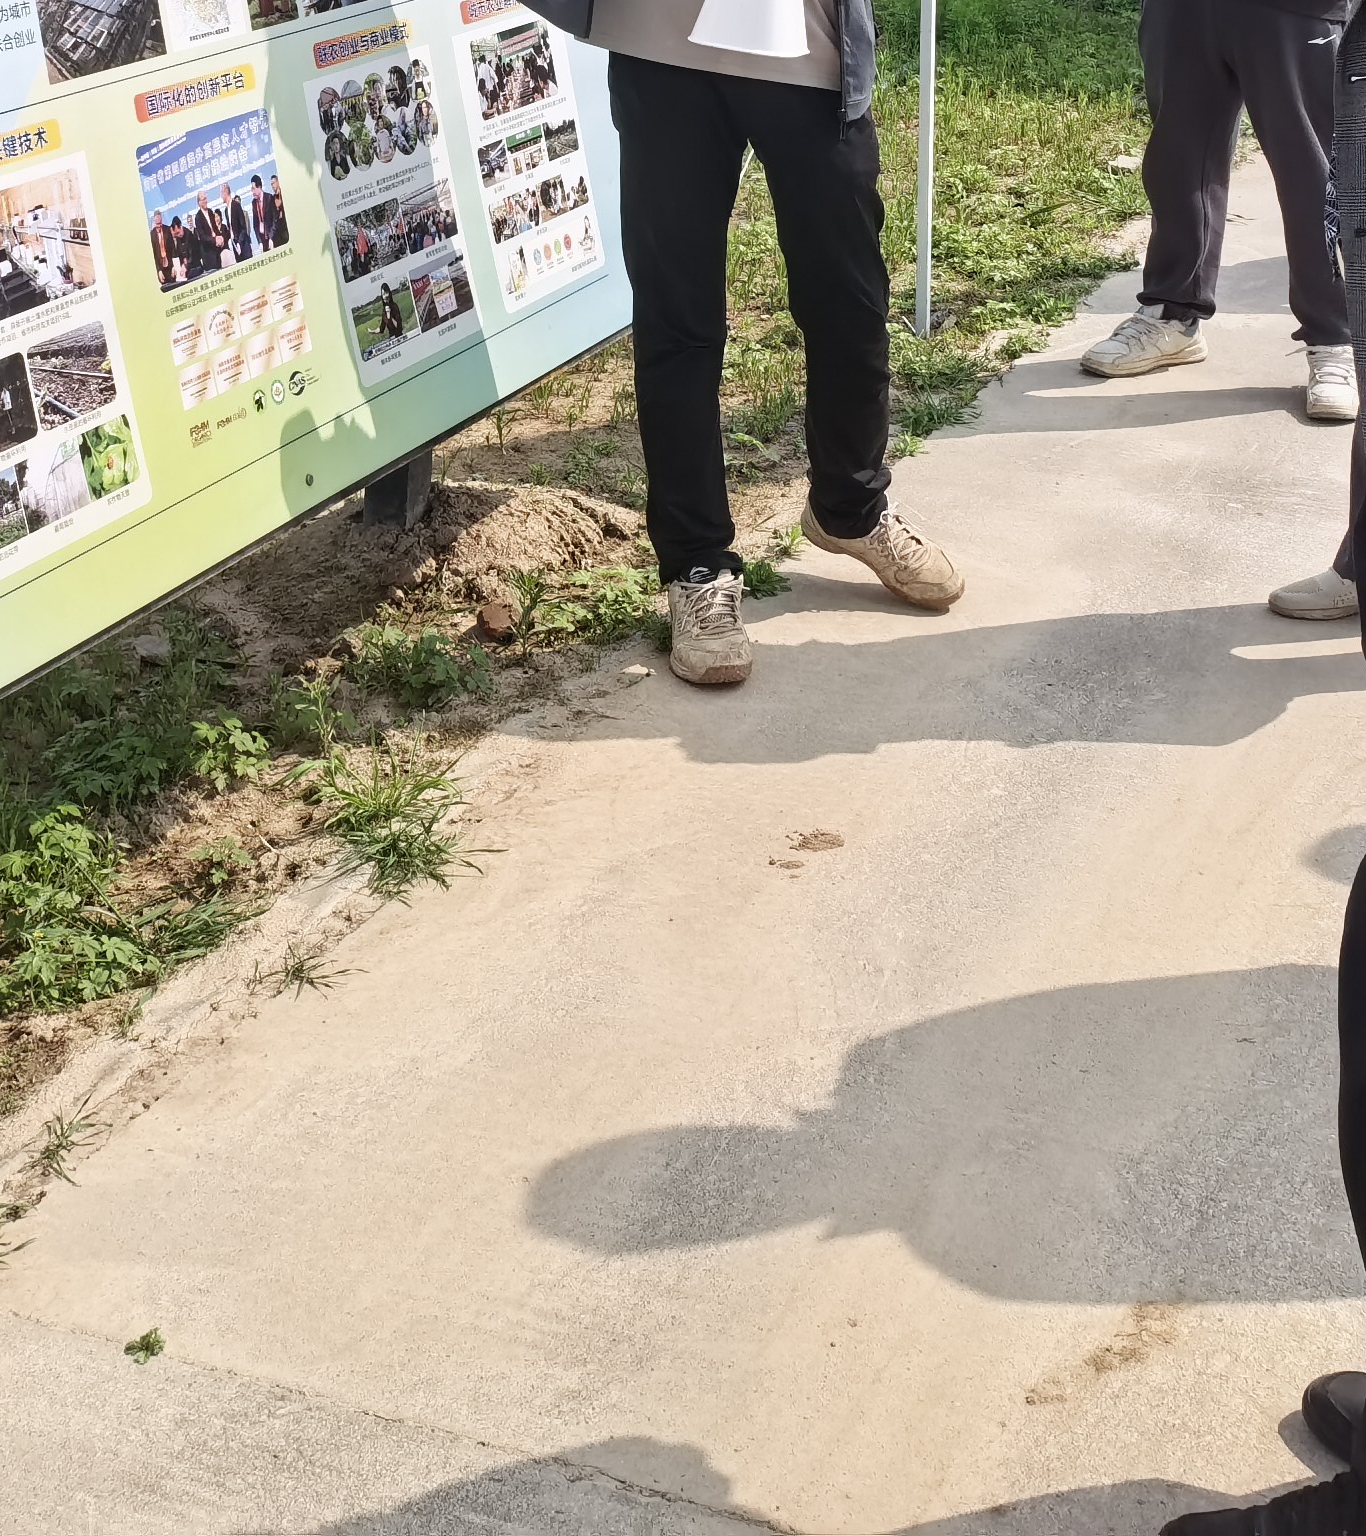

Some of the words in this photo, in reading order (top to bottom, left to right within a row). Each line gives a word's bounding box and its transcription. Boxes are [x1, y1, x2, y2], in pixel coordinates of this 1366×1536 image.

[145, 70, 246, 117] 国际化的创新平台
